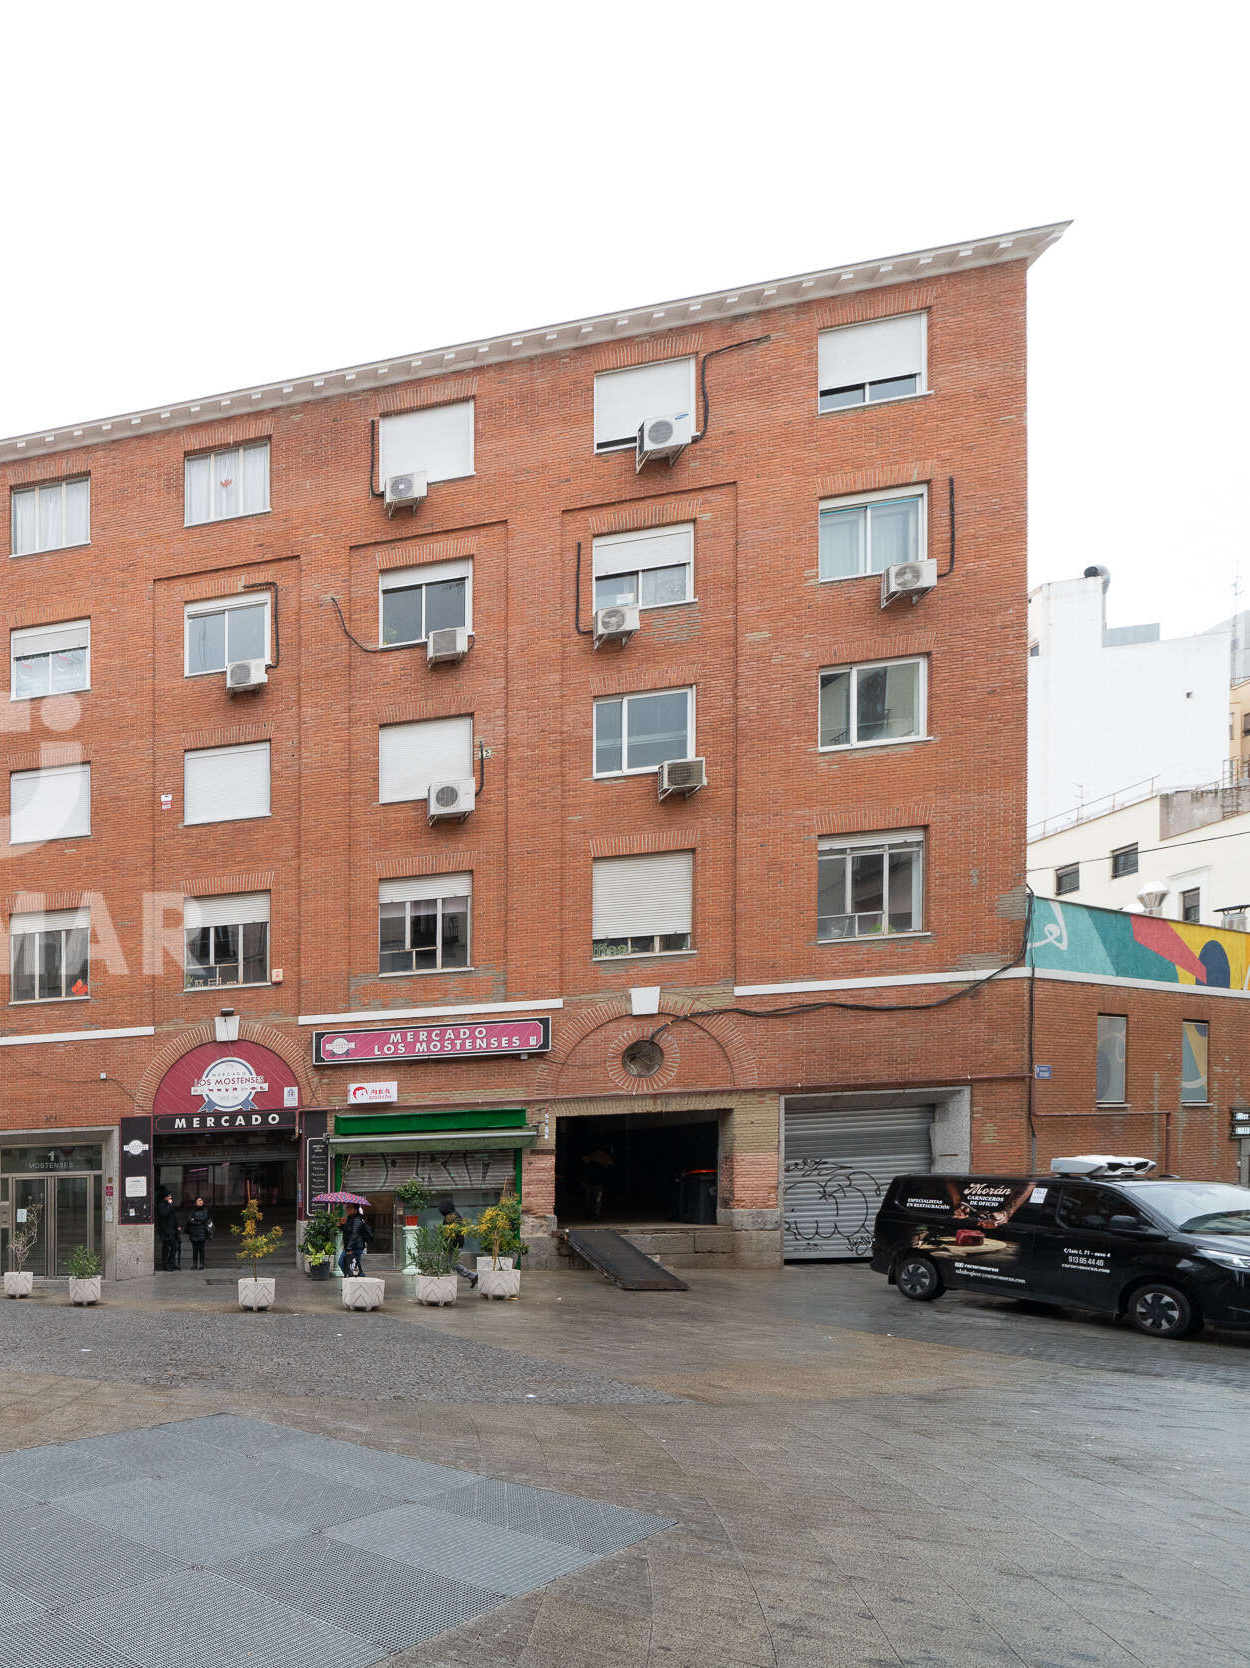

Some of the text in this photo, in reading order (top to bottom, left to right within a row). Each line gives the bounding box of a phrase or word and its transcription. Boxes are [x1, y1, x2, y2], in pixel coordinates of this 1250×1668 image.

[389, 1027, 487, 1043] MERCADO
[374, 1036, 521, 1055] LOS MOSTENSES
[194, 1076, 265, 1087] LOS MOSTENSES
[174, 1113, 280, 1129] MERCADO
[47, 1150, 55, 1161] 1
[29, 1161, 74, 1169] MOSTENSES
[963, 1183, 1012, 1196] Morán
